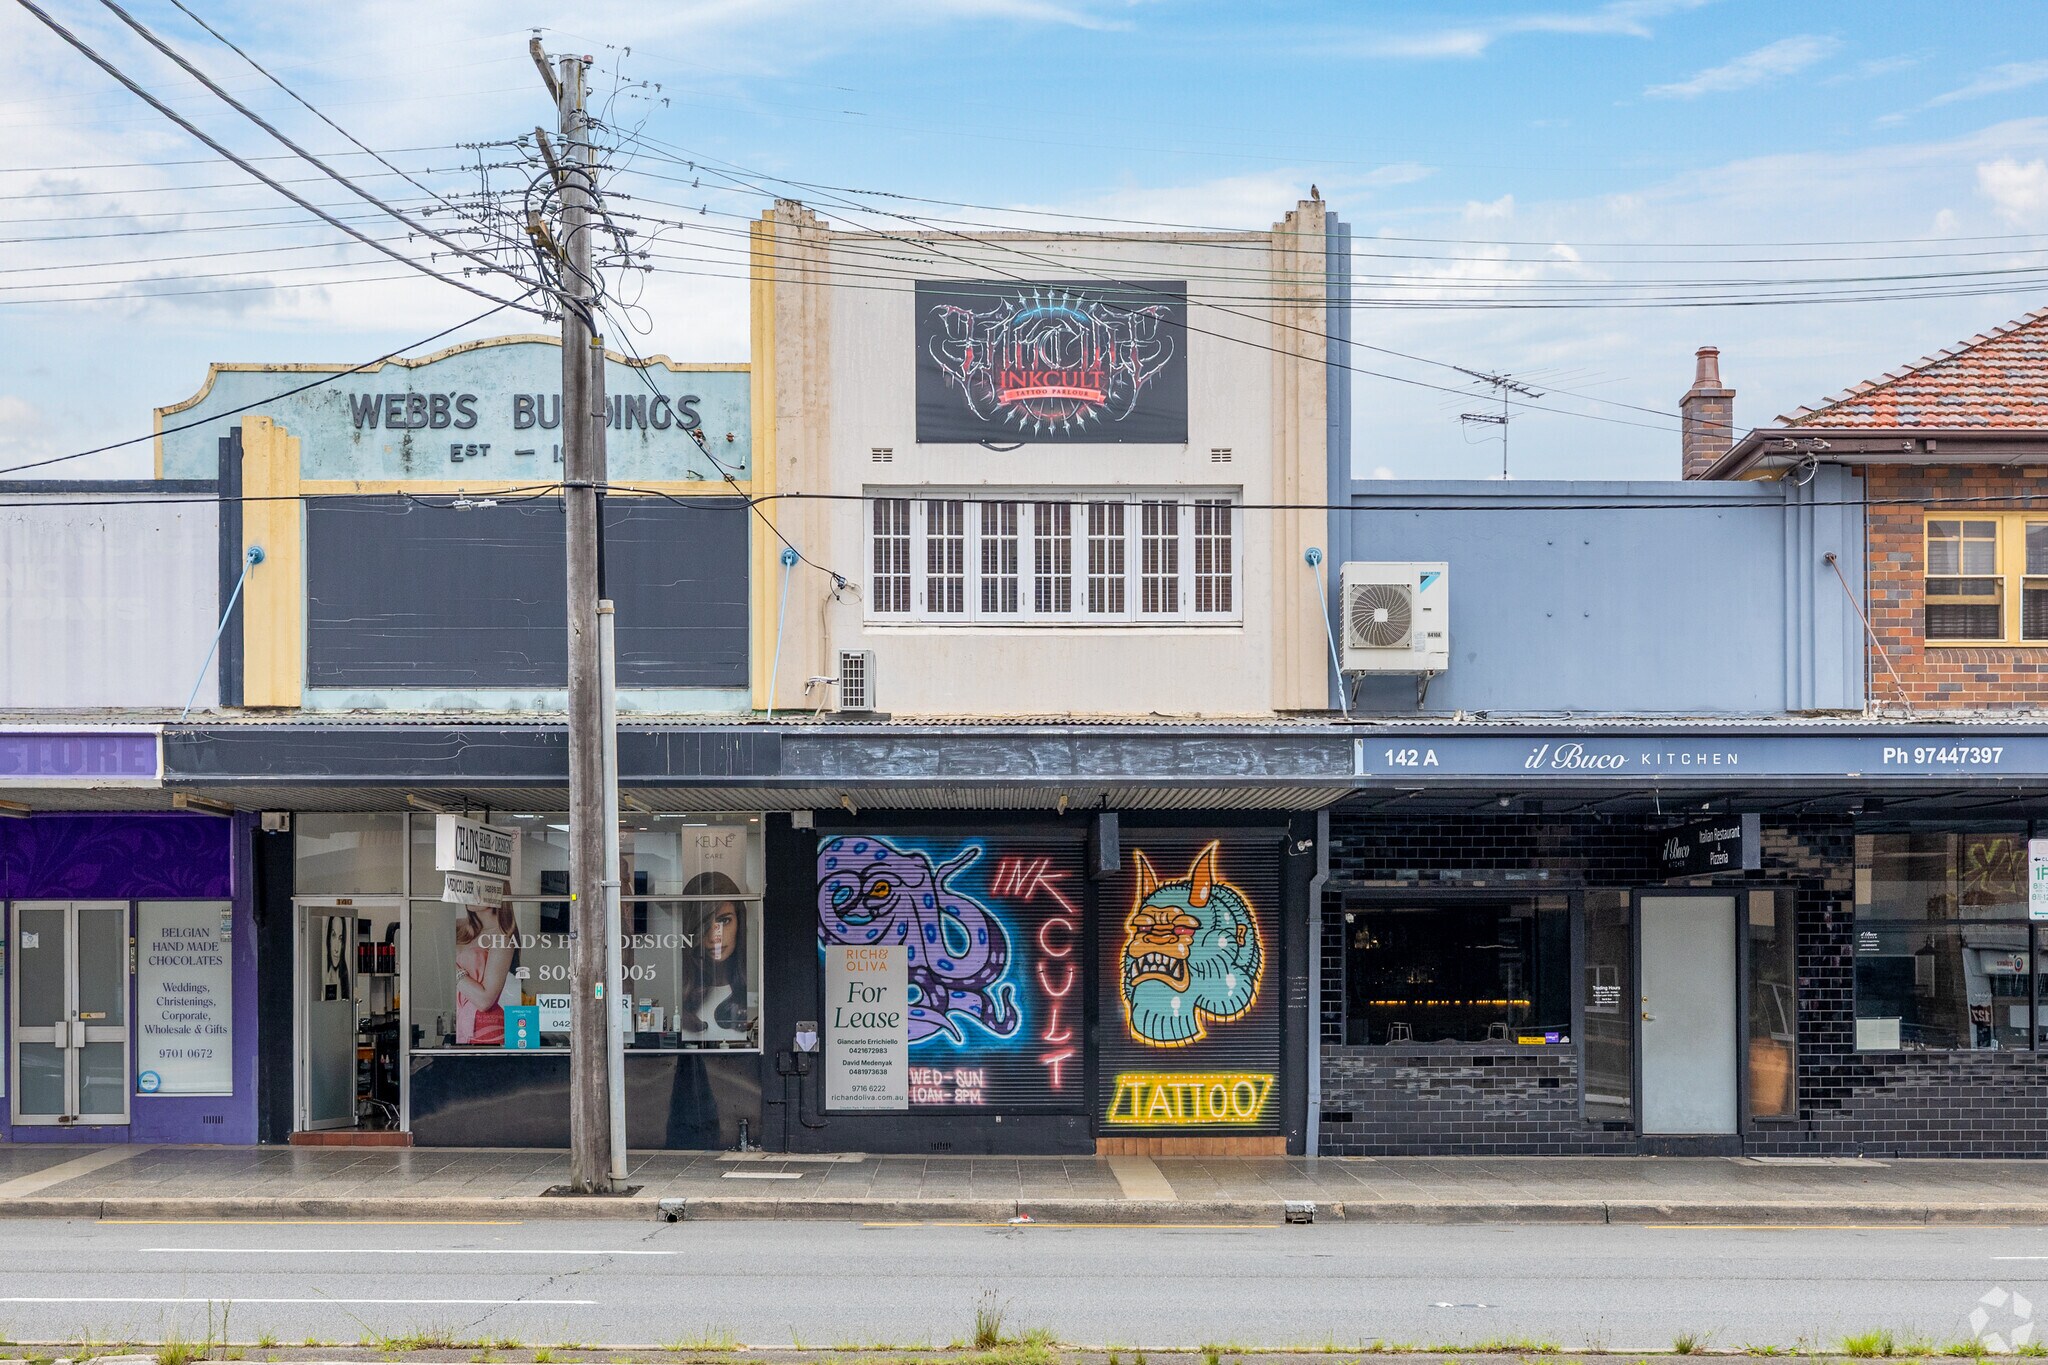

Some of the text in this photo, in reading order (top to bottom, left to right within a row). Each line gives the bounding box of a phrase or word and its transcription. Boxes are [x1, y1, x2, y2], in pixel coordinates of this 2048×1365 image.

[1001, 371, 1104, 388] INKCULT
[1016, 388, 1089, 397] TATTOO PARLOUR
[349, 390, 478, 429] WEBB'S
[451, 443, 491, 462] EST
[1384, 749, 1439, 766] 142 A
[1524, 742, 1738, 769] il Buco KITCHEN
[1883, 747, 2004, 765] Ph 97447397
[1699, 825, 1740, 843] Italian Restaurant
[1670, 837, 1690, 859] Buco
[1710, 850, 1729, 865] Pizzeria
[992, 858, 1073, 913] INK
[161, 928, 210, 937] BELGIAN
[152, 942, 219, 951] HAND MADE
[477, 933, 552, 949] CHAD'S
[148, 956, 223, 966] CHOCOLATES
[846, 961, 887, 971] OLIVA
[162, 982, 210, 994] Weddings,
[596, 986, 602, 996] H
[847, 981, 887, 1003] For
[156, 996, 216, 1008] Christenings,
[539, 998, 570, 1009] MEDI
[161, 1010, 211, 1022] Corporate,
[834, 1007, 900, 1029] Lease
[144, 1024, 228, 1034] Wholesale & Gifts
[159, 1049, 213, 1058] 9701 0672
[1126, 1079, 1258, 1120] TATTOO
